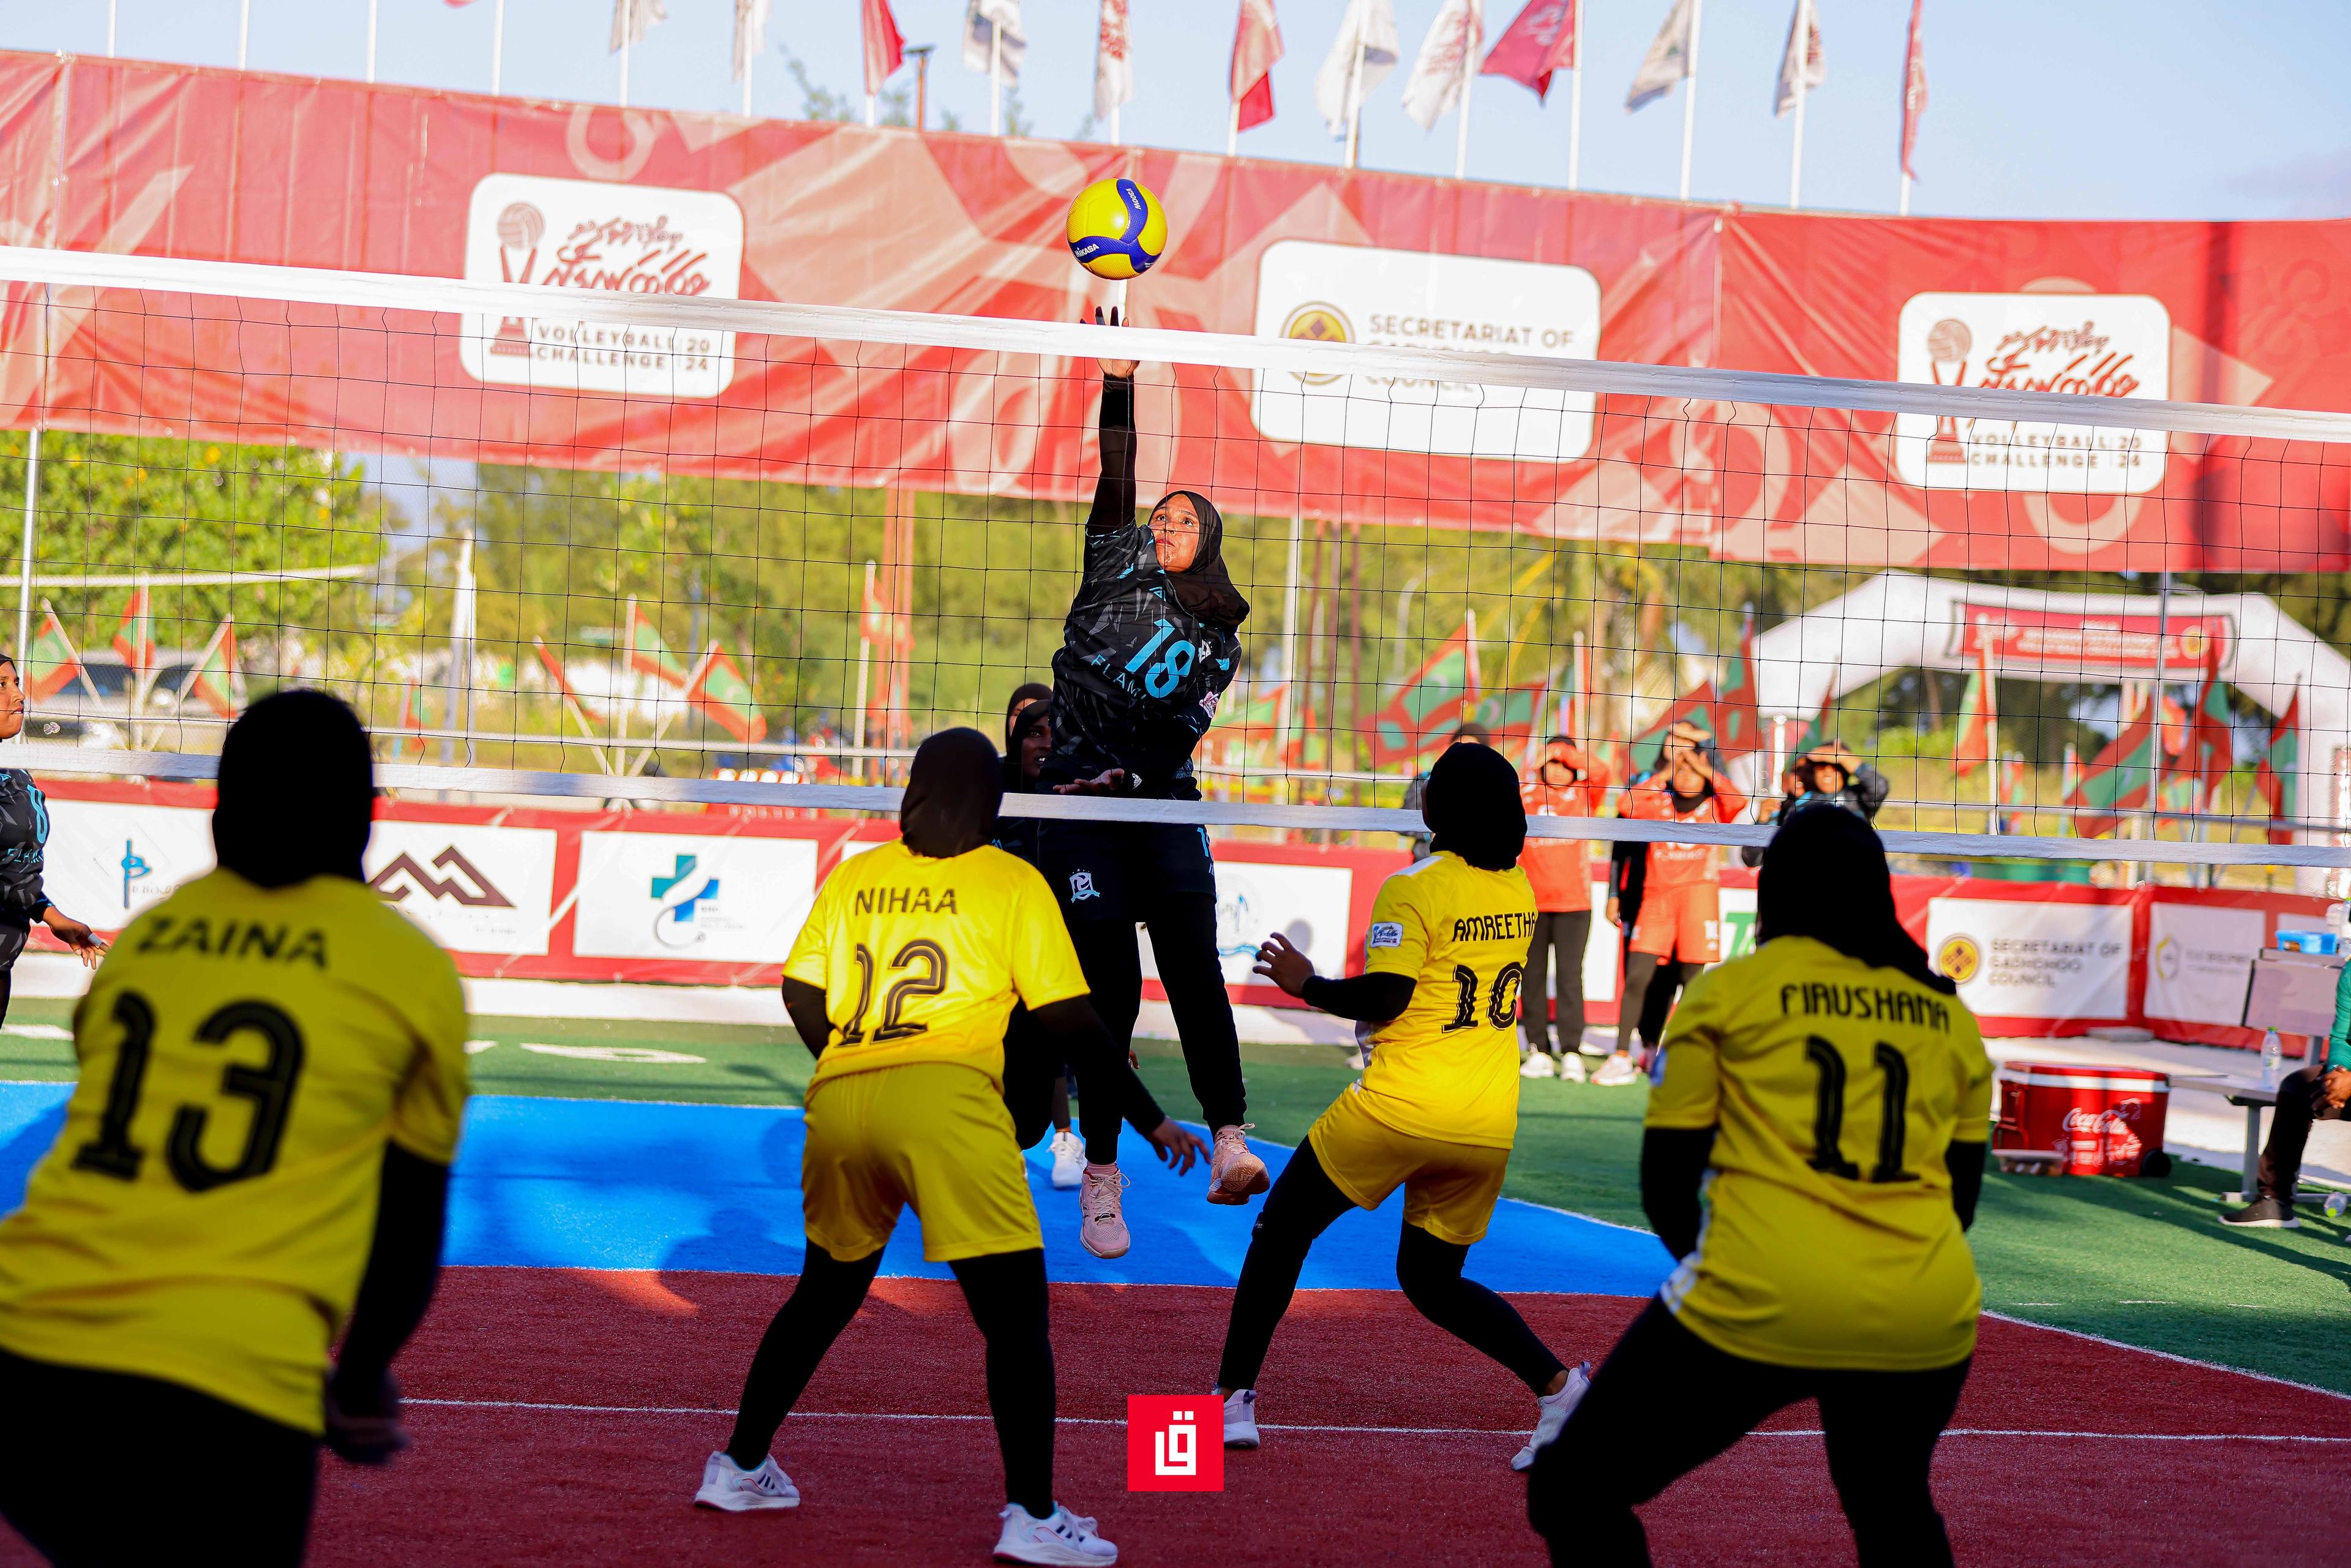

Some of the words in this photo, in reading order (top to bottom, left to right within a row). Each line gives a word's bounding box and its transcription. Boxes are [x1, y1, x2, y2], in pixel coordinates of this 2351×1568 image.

[1125, 188, 1142, 210] V300W
[538, 324, 673, 348] VOLLEYBALL
[1369, 314, 1532, 346] SECRETARIAT
[1541, 329, 1575, 349] OF
[536, 345, 667, 368] CHALLENGE
[685, 337, 710, 354] 20
[684, 356, 710, 371] 24
[1971, 433, 2107, 449] VOLLEYBALL
[2117, 435, 2142, 449] 20
[1970, 452, 2099, 468] CHALLENGE
[1124, 618, 1196, 699] 18
[854, 887, 958, 916] NIHAA
[1451, 911, 1535, 942] AMREETHA
[136, 915, 329, 970] ZAINA
[1991, 939, 2095, 955] SECRETARIAT
[2100, 942, 2121, 958] OF
[1989, 971, 2057, 988] COUNCIL
[834, 939, 949, 1048] 12
[1441, 961, 1524, 1034] 10
[1780, 981, 1951, 1035] FIRUSHANA
[69, 987, 309, 1195] 13
[1805, 1033, 1922, 1184] 11
